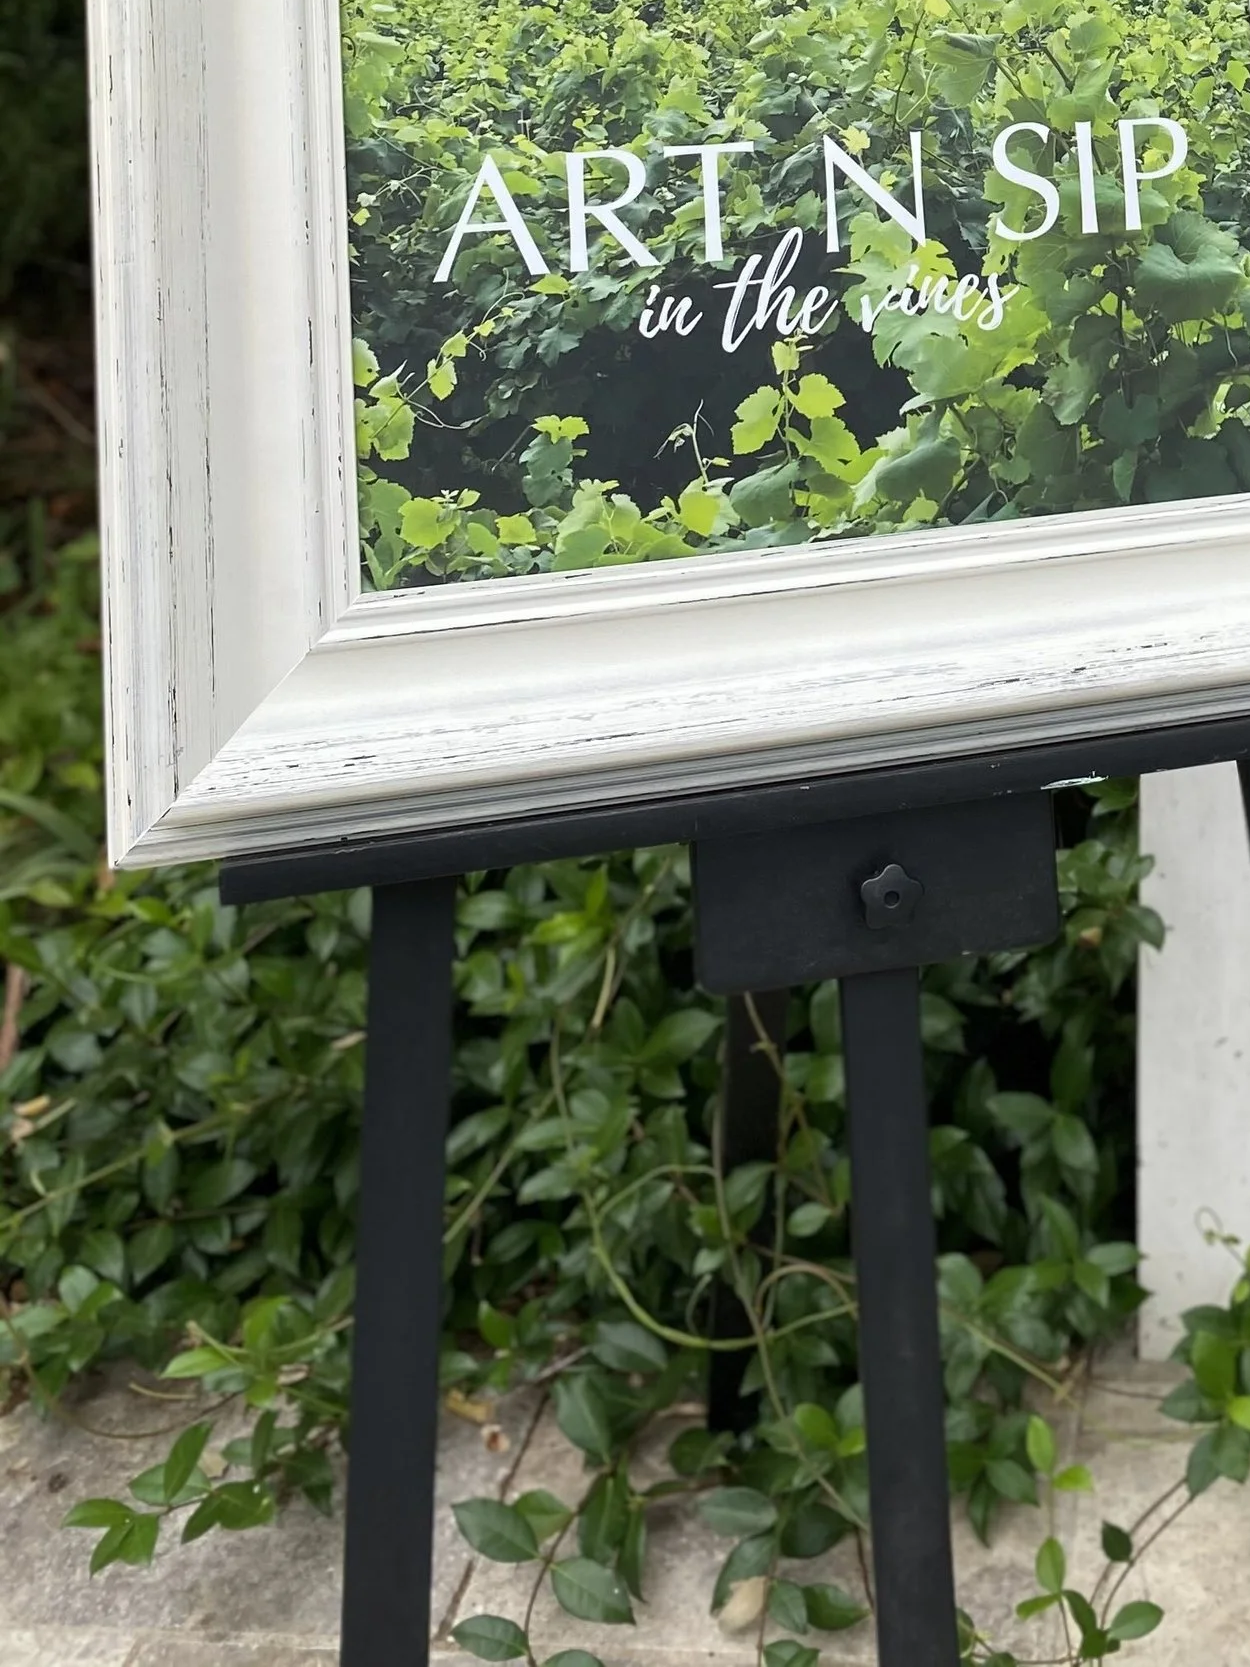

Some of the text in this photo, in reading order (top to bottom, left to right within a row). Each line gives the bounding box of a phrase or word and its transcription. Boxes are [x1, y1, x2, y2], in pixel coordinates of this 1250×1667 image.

[432, 117, 1189, 284] ART N SIP
[638, 226, 1021, 354] in the vines
